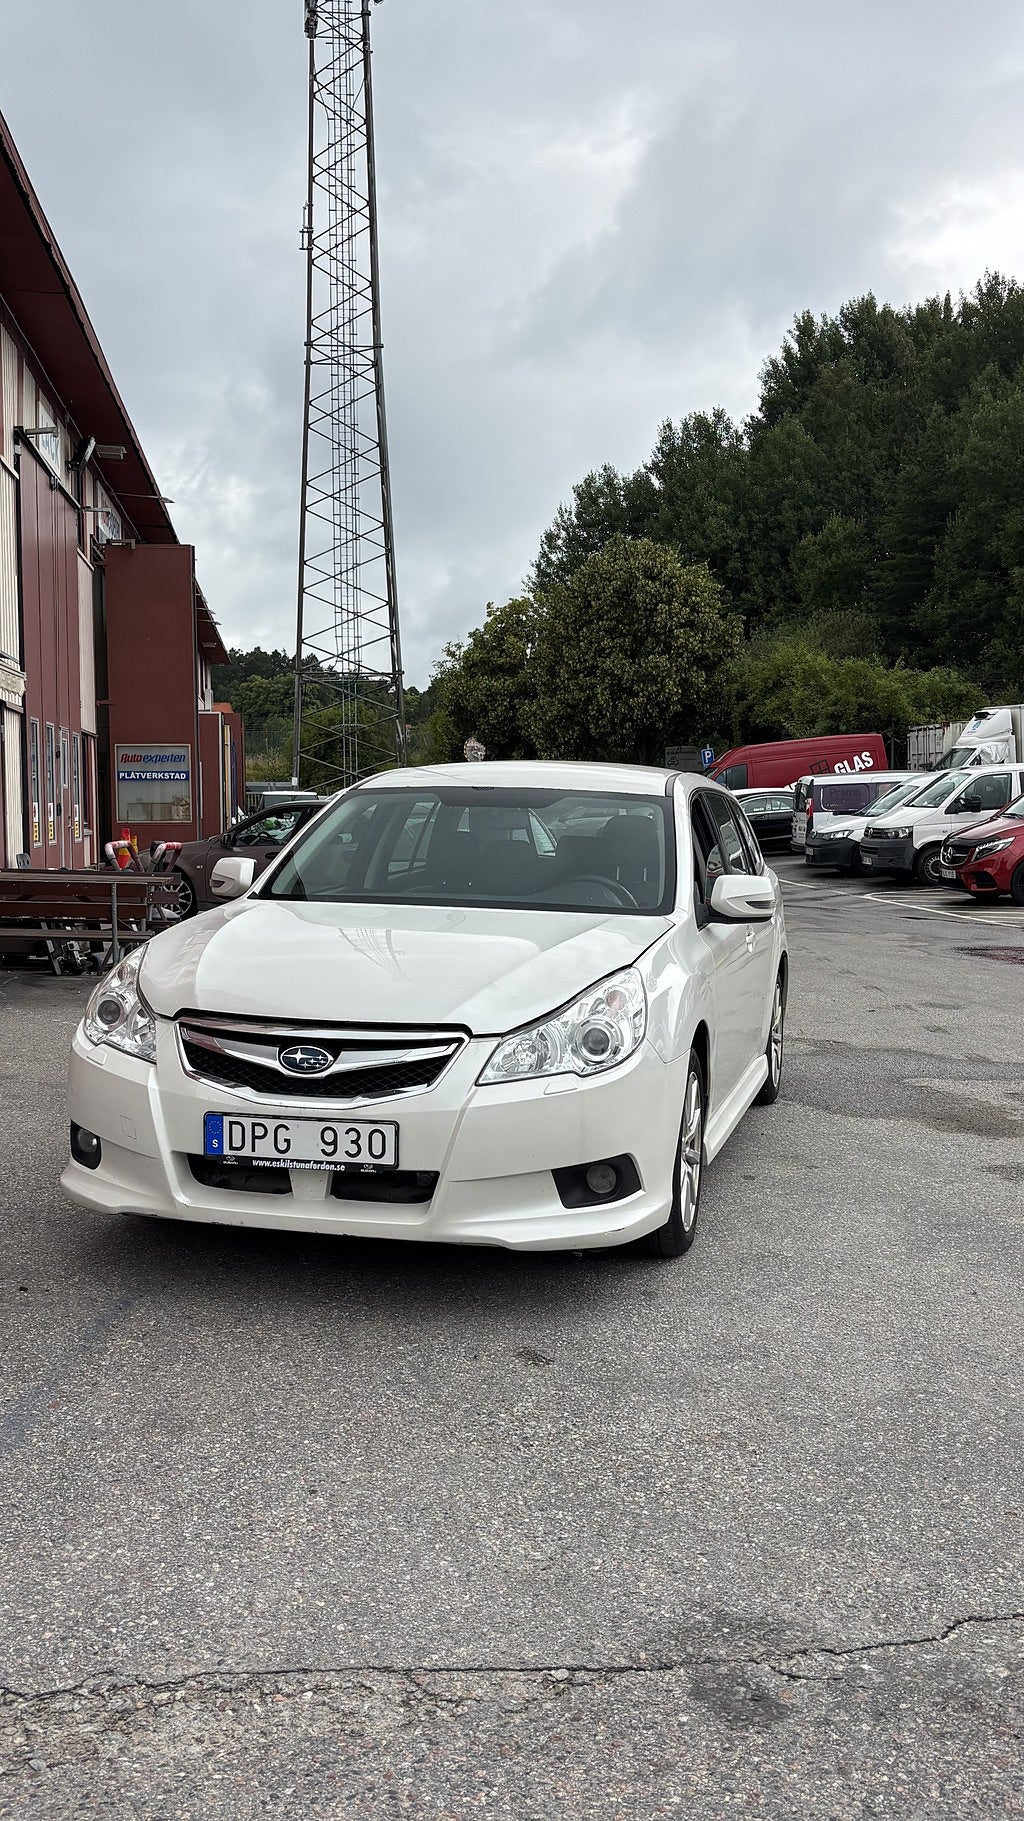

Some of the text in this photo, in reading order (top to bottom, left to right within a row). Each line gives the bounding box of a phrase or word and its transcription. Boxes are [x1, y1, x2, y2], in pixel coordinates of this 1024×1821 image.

[120, 753, 186, 764] Autoexperten
[704, 750, 712, 763] P
[833, 751, 874, 774] GLAS
[119, 771, 187, 780] PLÅTVERKSTAD
[212, 1139, 219, 1148] S
[228, 1120, 387, 1160] DPG 930
[252, 1158, 346, 1172] www.eskilstunafordon.se
